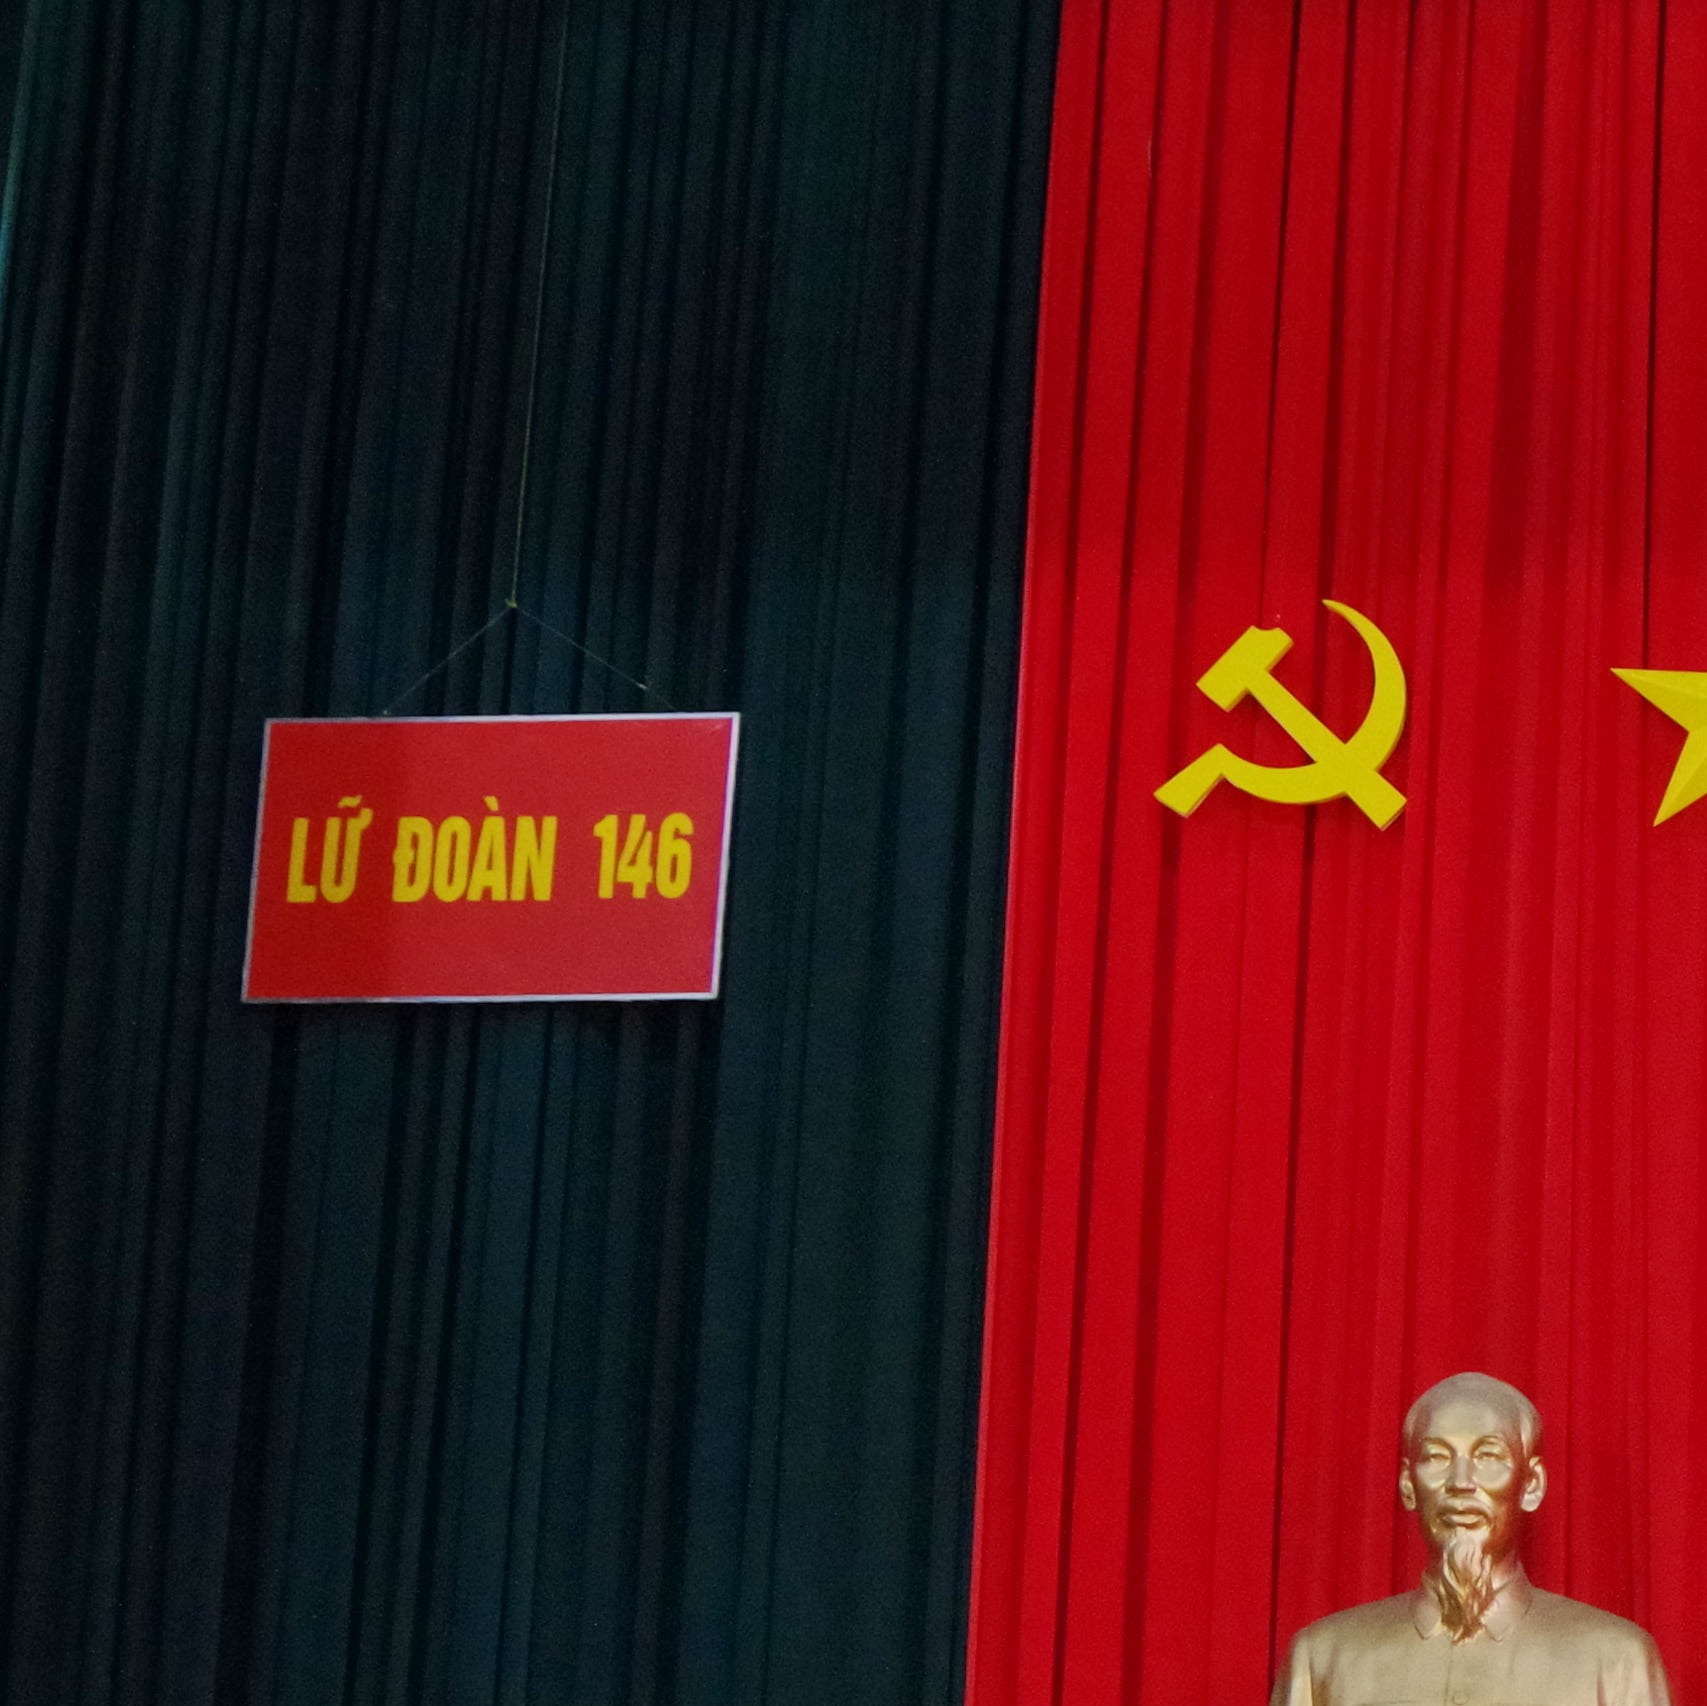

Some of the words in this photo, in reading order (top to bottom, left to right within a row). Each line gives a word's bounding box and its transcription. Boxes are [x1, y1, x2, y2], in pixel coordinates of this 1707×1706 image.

[286, 795, 373, 903] LỮ
[392, 796, 557, 902] ĐOÀN
[593, 812, 693, 899] 146
